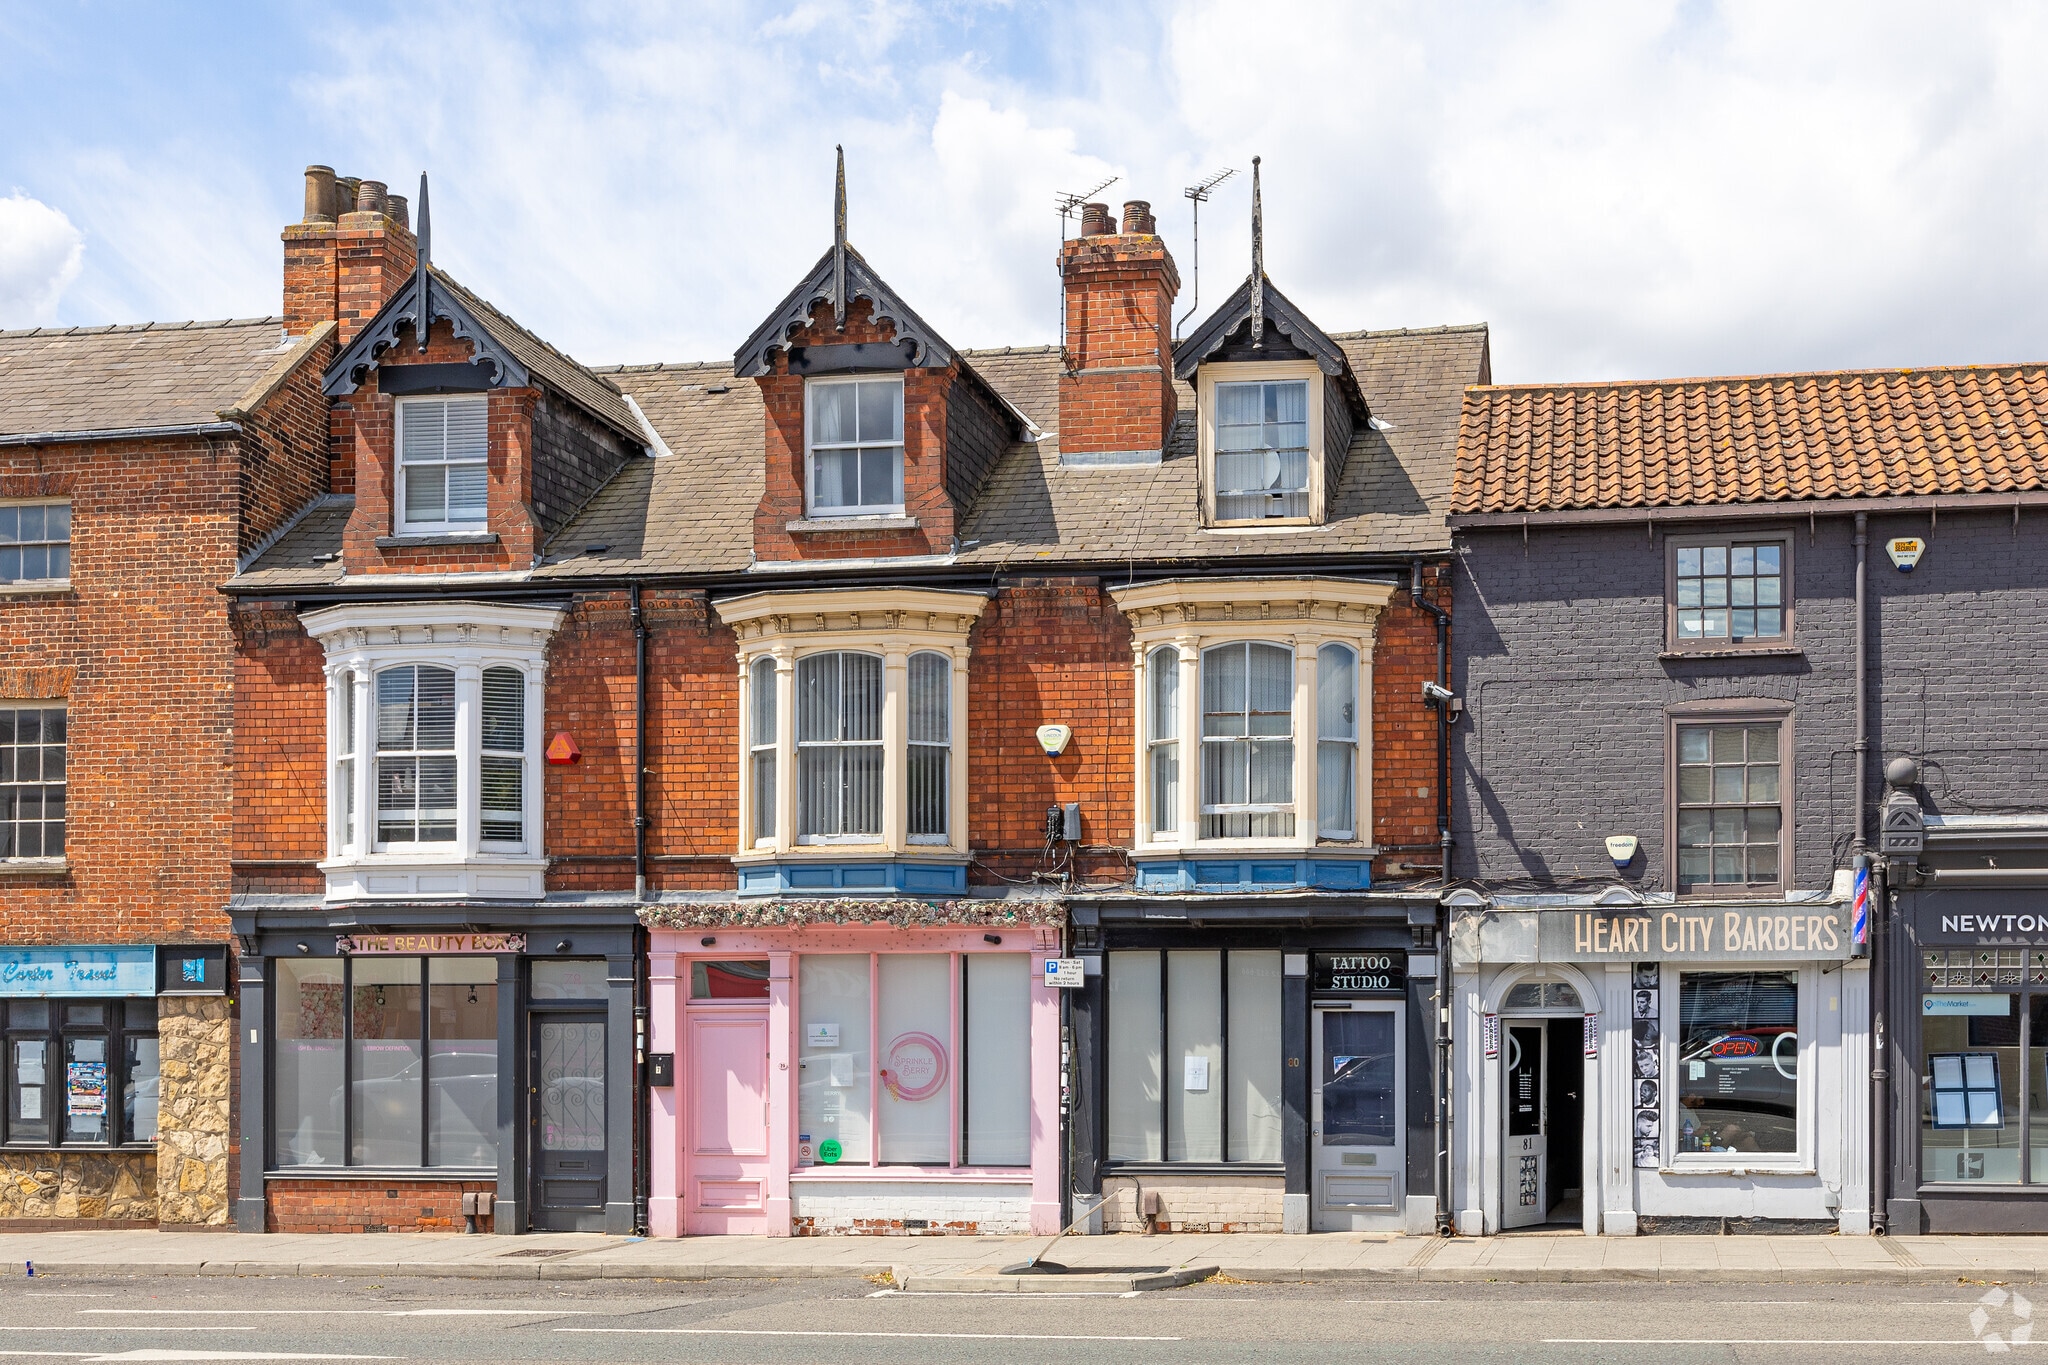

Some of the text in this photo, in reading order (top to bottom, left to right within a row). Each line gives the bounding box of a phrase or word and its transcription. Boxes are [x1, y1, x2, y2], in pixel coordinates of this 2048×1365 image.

[1575, 912, 1839, 953] HEART CITY BARBERS
[356, 936, 507, 951] THE BEAUTY BOX
[1048, 962, 1057, 973] P
[1331, 957, 1391, 969] TATTOO
[64, 960, 118, 981] Travel
[1331, 976, 1390, 988] STUDIO
[1712, 1042, 1758, 1055] OPEN
[894, 1055, 933, 1067] SPRINKLE
[1288, 1057, 1299, 1067] 80
[902, 1064, 929, 1076] BERRY
[1523, 1138, 1532, 1150] 81
